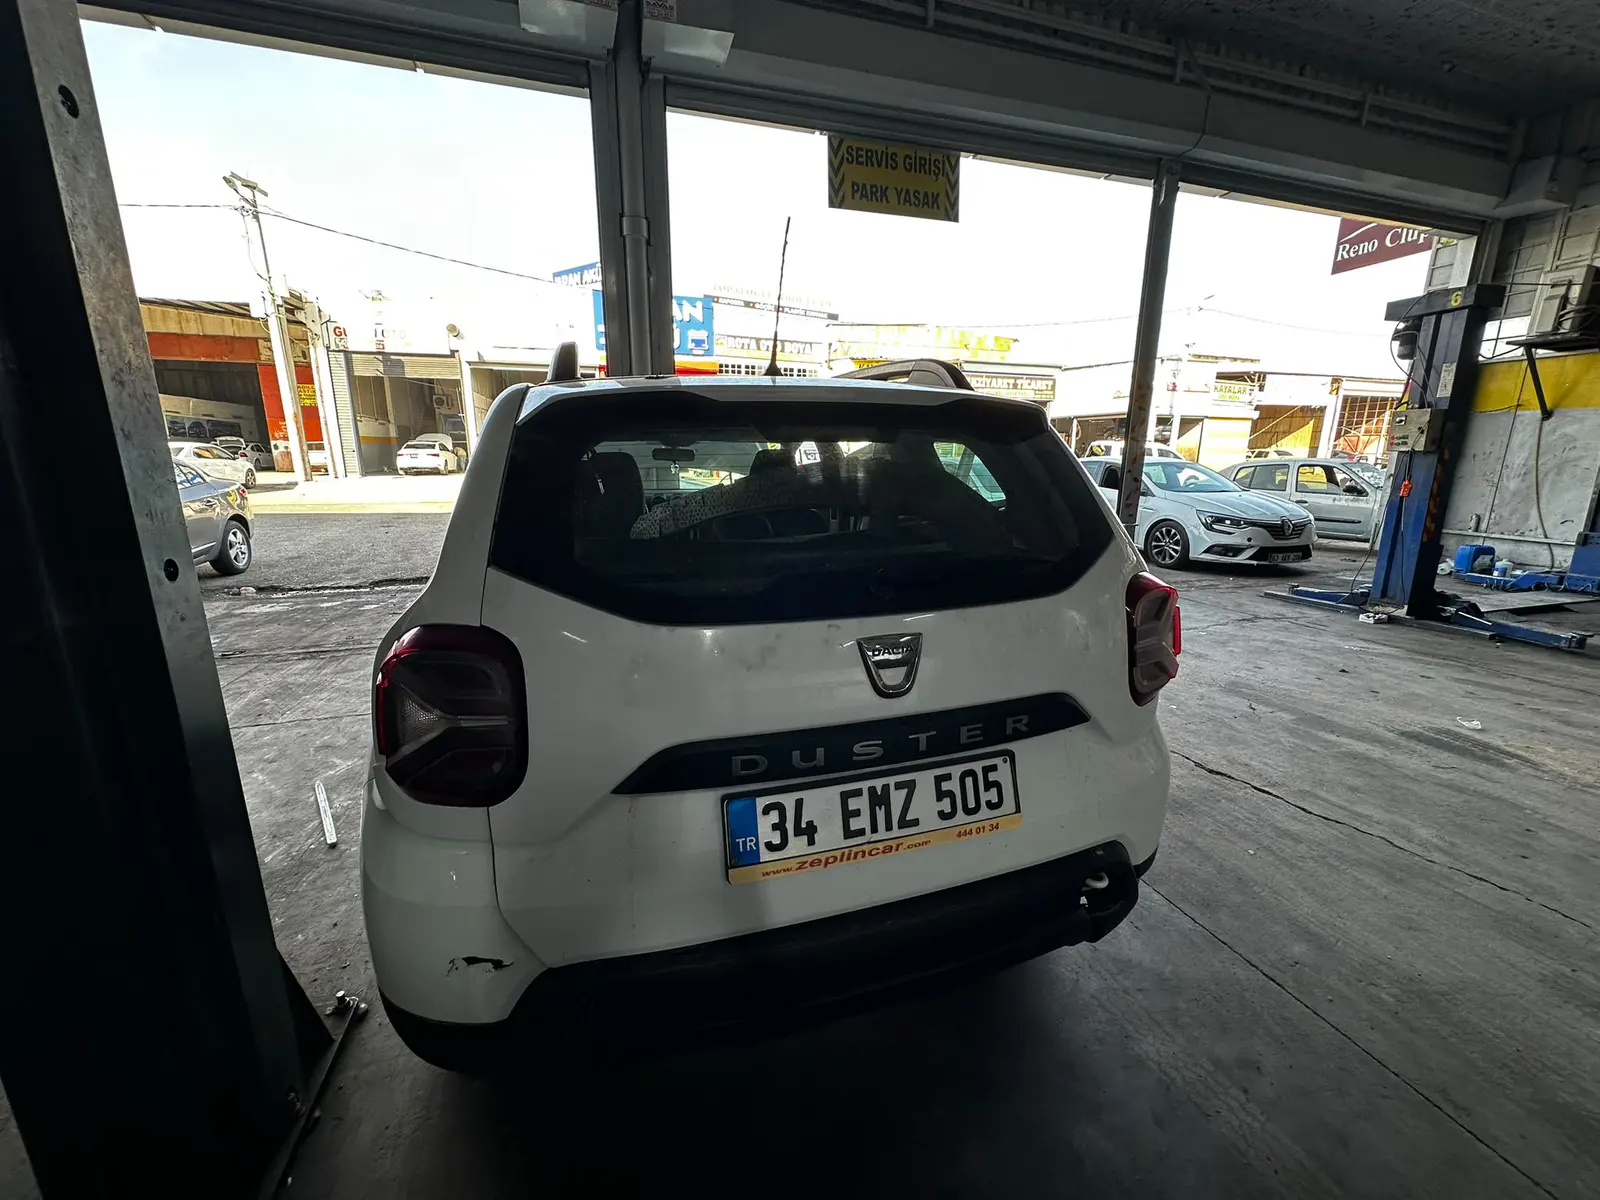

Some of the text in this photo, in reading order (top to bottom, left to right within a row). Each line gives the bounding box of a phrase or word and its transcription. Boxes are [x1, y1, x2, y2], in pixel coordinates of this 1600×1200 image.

[845, 145, 946, 181] SERVİS GİRİŞİ
[851, 181, 940, 210] PARK YASAK
[1336, 239, 1378, 262] Reno
[1450, 290, 1462, 306] 6
[872, 645, 915, 657] DACIA
[731, 714, 1030, 777] DUSTER
[761, 763, 1004, 852] 34 EMZ 505
[956, 823, 1000, 839] 444 01 34
[736, 837, 757, 852] TR
[760, 840, 932, 878] www.zeplincar.com
